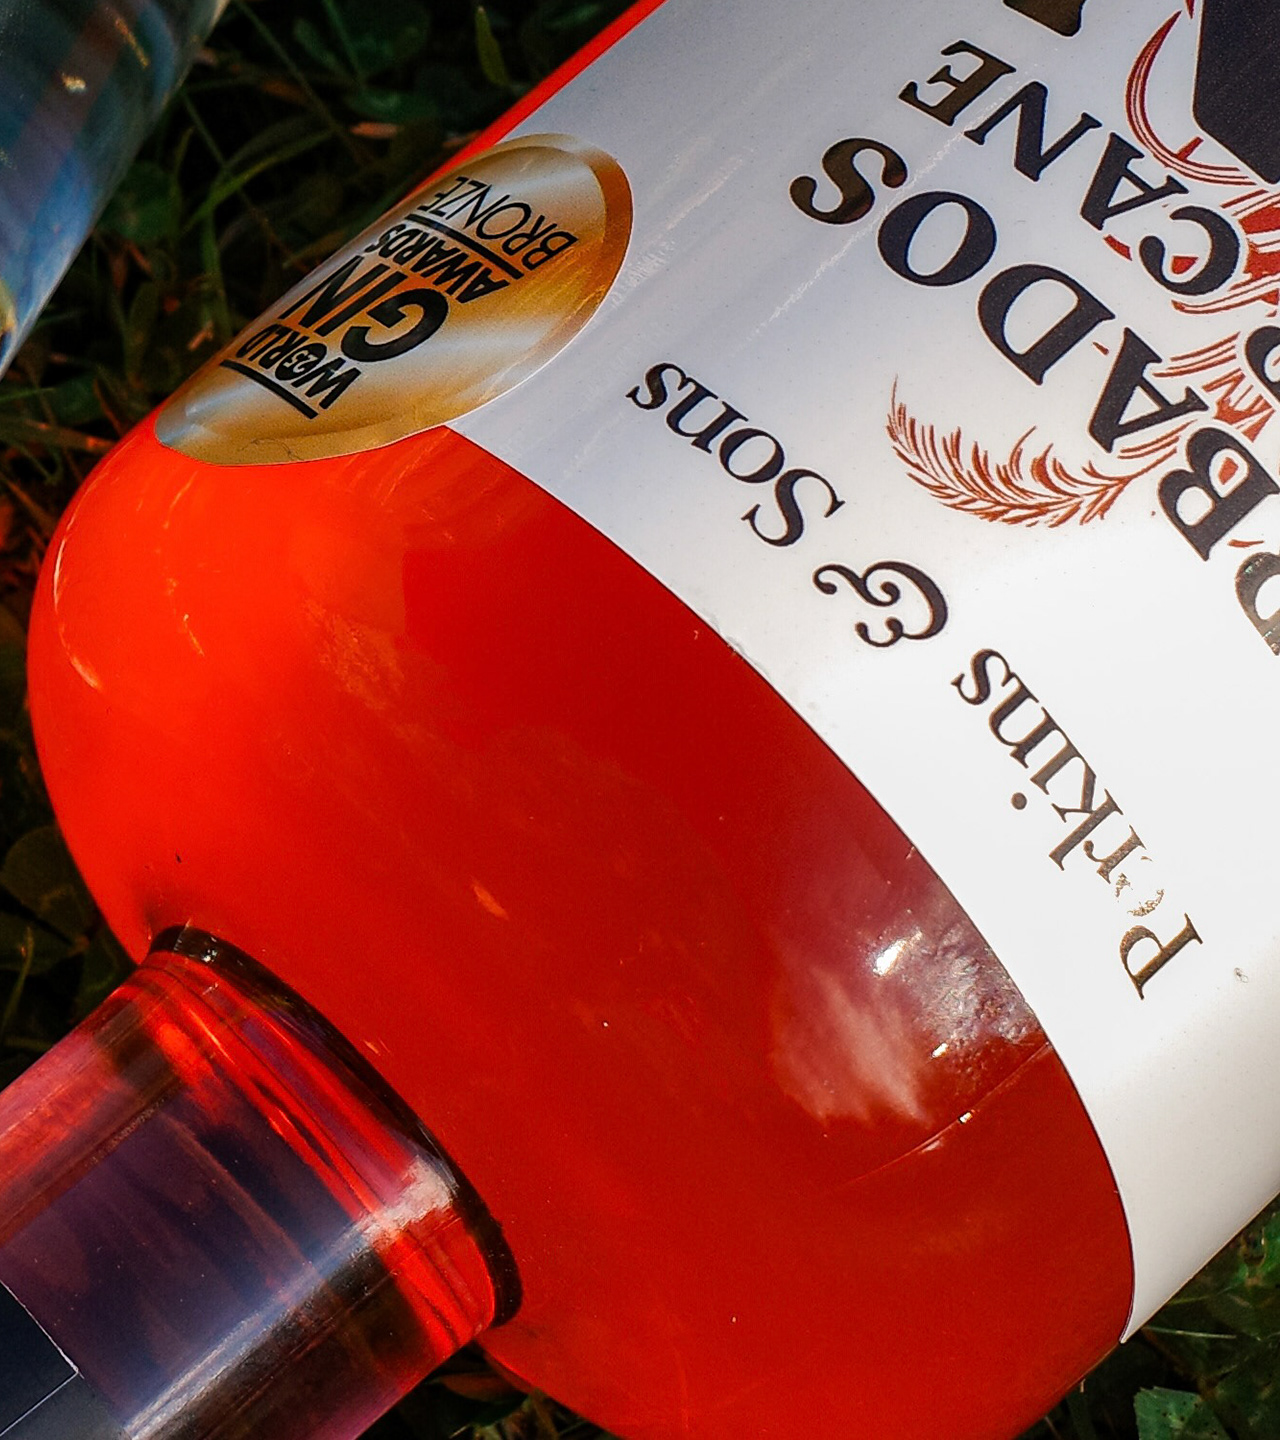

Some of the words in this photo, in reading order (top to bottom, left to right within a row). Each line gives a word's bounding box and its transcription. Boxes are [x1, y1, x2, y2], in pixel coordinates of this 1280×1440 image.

[899, 40, 1240, 296] CANE
[365, 223, 510, 304] AWARDS
[418, 176, 579, 271] BRONZE
[278, 255, 449, 363] GIN
[626, 362, 846, 548] Sons
[813, 561, 949, 648] &
